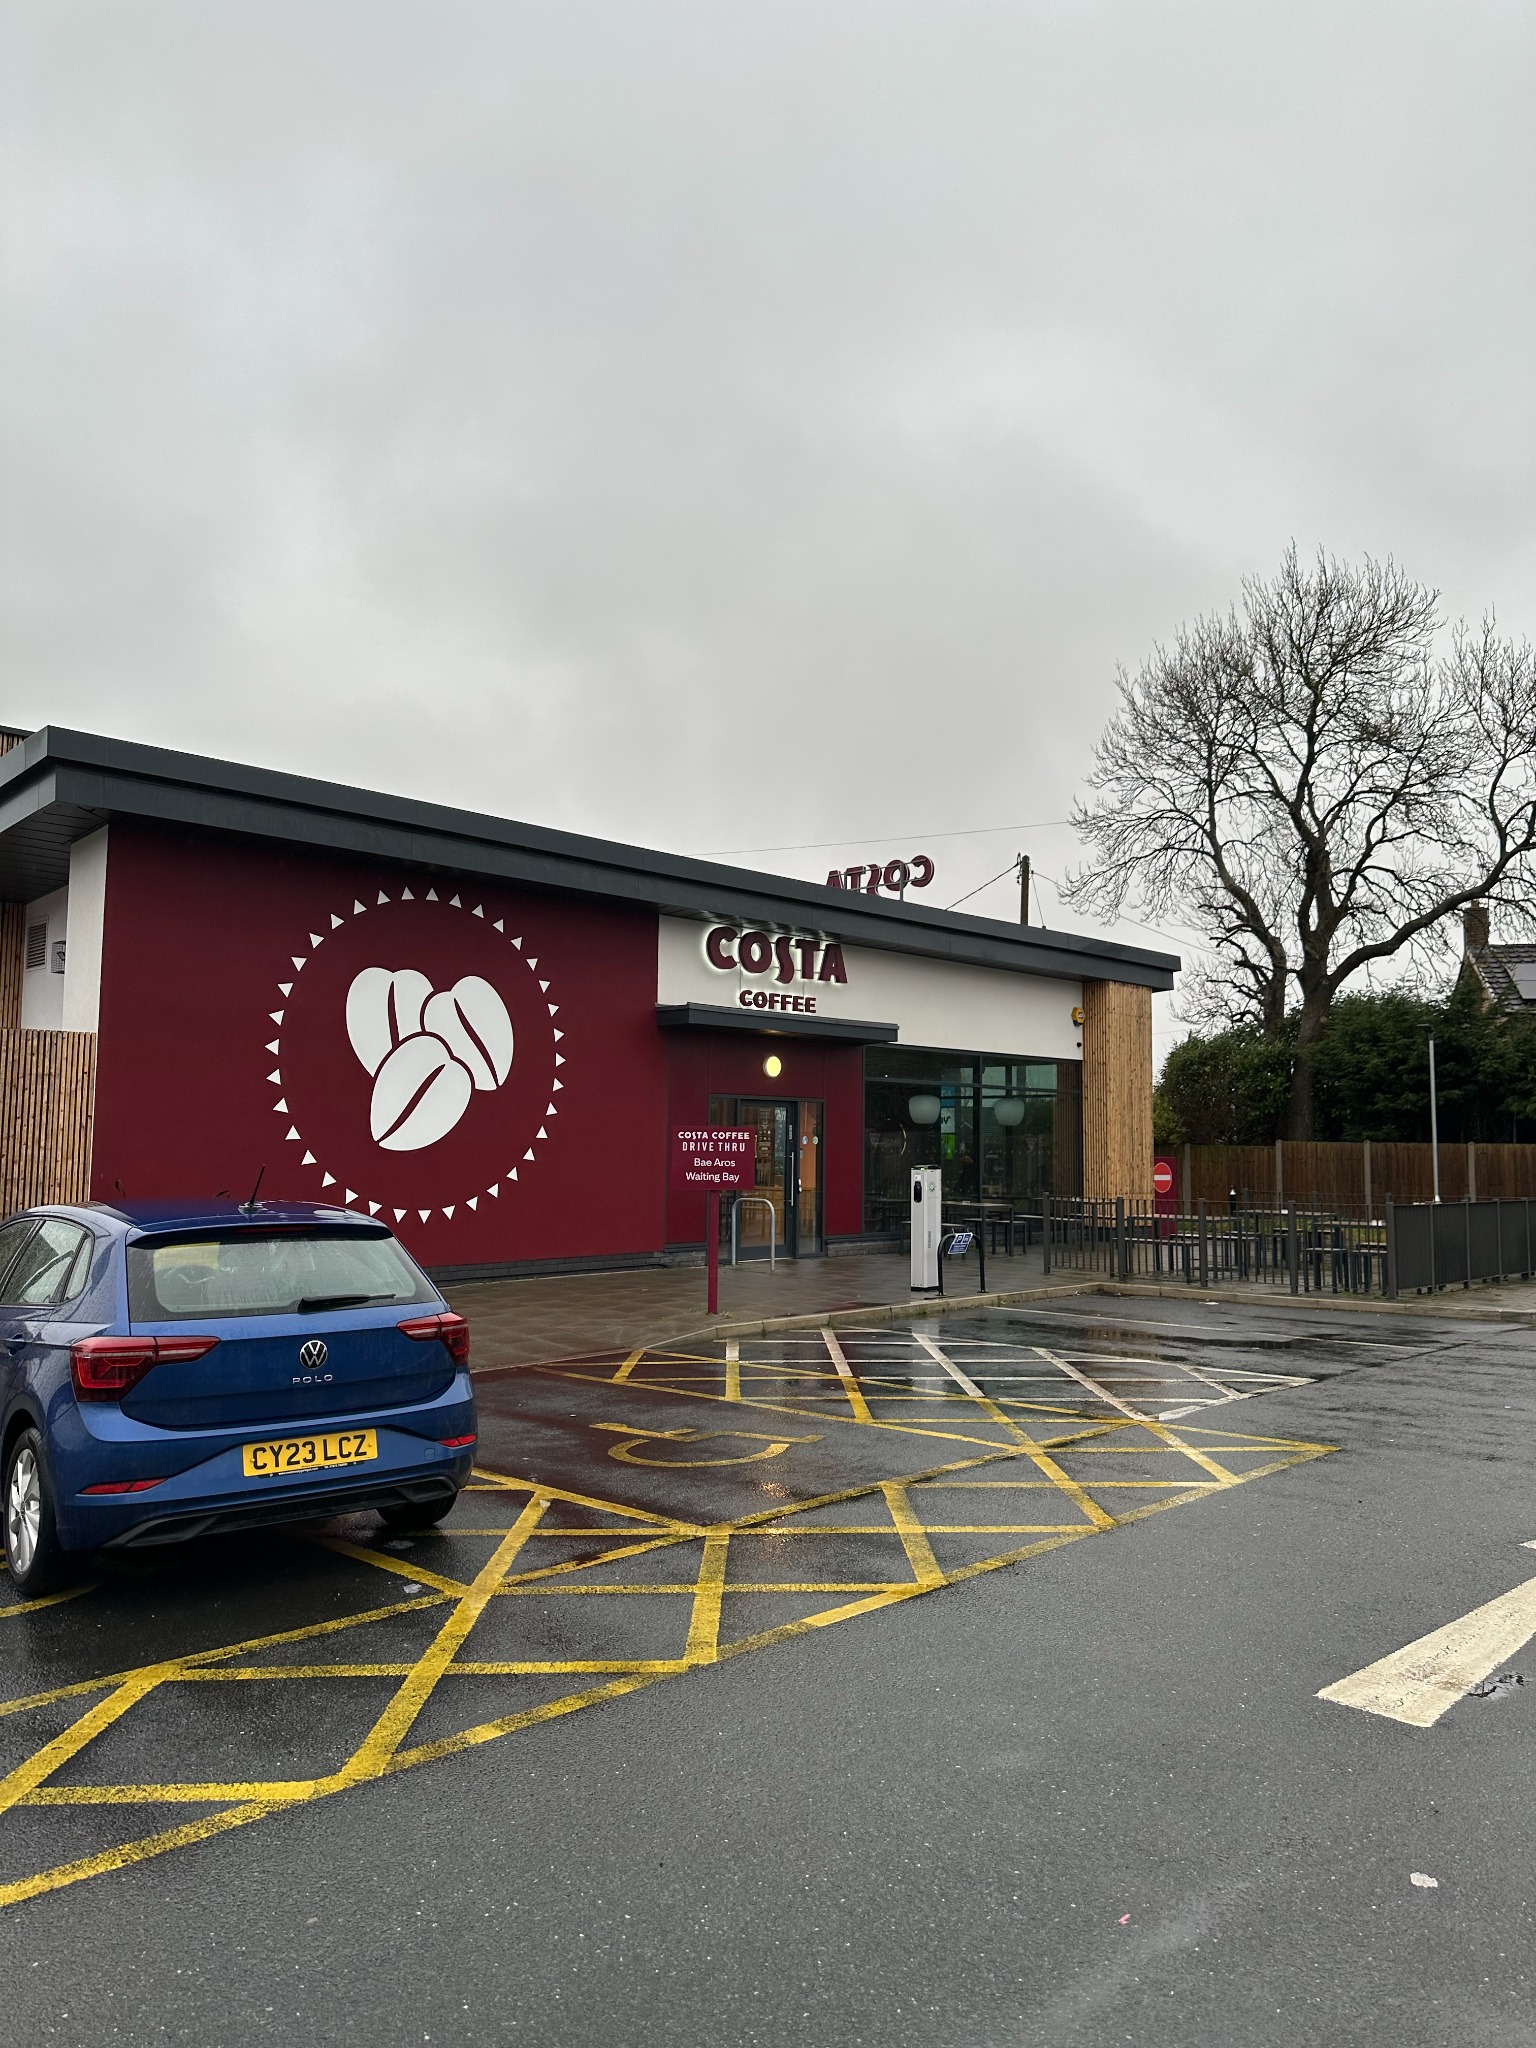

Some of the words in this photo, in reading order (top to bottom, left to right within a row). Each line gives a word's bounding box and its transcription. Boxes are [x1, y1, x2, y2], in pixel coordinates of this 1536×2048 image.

[706, 926, 848, 984] COSTA
[739, 989, 817, 1013] COFFEE
[678, 1131, 708, 1140] COSTA
[711, 1132, 750, 1140] COFFEE
[682, 1141, 715, 1151] DRIVE
[718, 1142, 746, 1152] THRU
[694, 1157, 712, 1167] Bae
[713, 1158, 736, 1167] Aros
[685, 1171, 721, 1183] Waiting
[722, 1172, 740, 1183] Bay
[292, 1374, 333, 1385] POLO
[252, 1440, 316, 1471] CY23
[322, 1434, 367, 1462] LCZ
